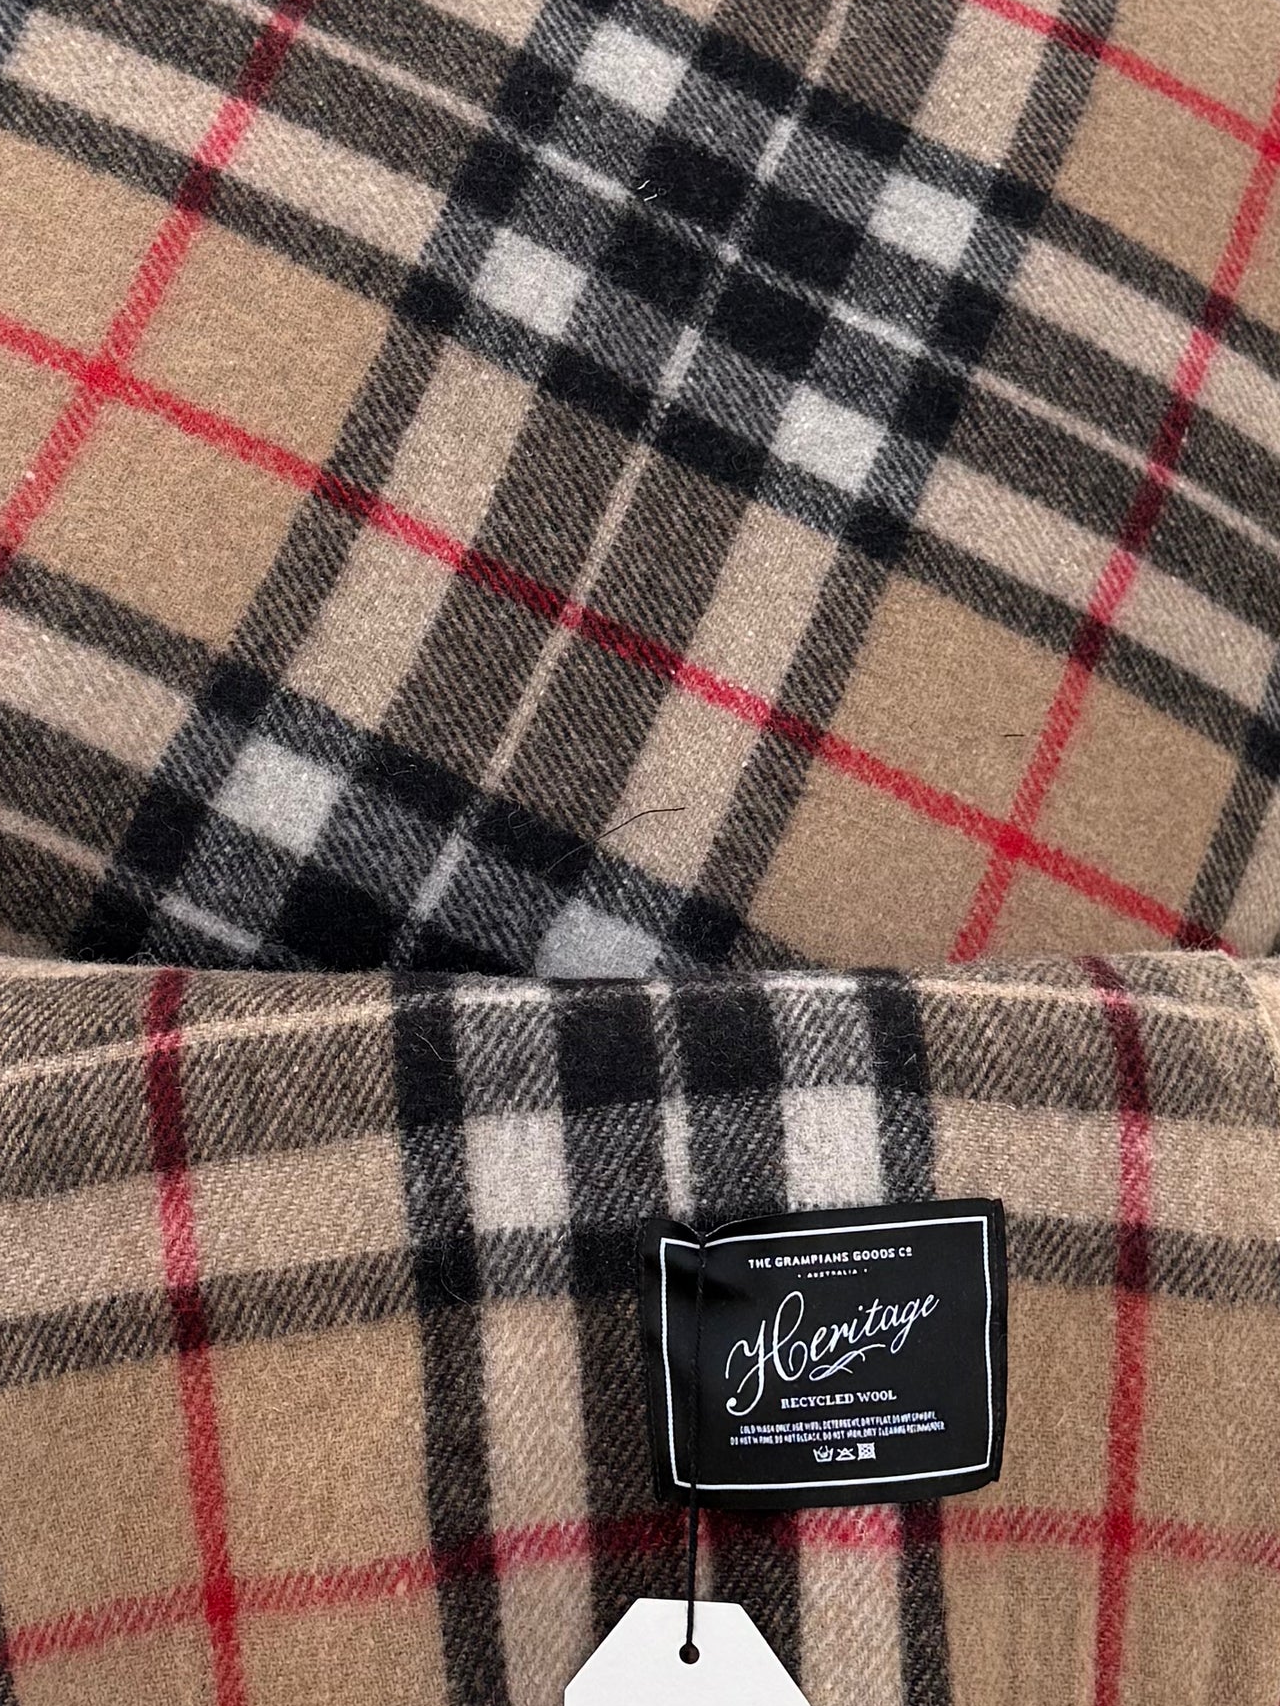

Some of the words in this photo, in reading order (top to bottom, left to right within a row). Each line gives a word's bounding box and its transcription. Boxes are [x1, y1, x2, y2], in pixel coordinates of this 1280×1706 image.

[747, 1257, 772, 1269] THE
[774, 1251, 849, 1268] GRAMPIANS
[852, 1247, 896, 1262] GOODS
[724, 1290, 940, 1416] Heritage
[780, 1393, 855, 1410] RECYCLED
[856, 1389, 897, 1403] WOOL
